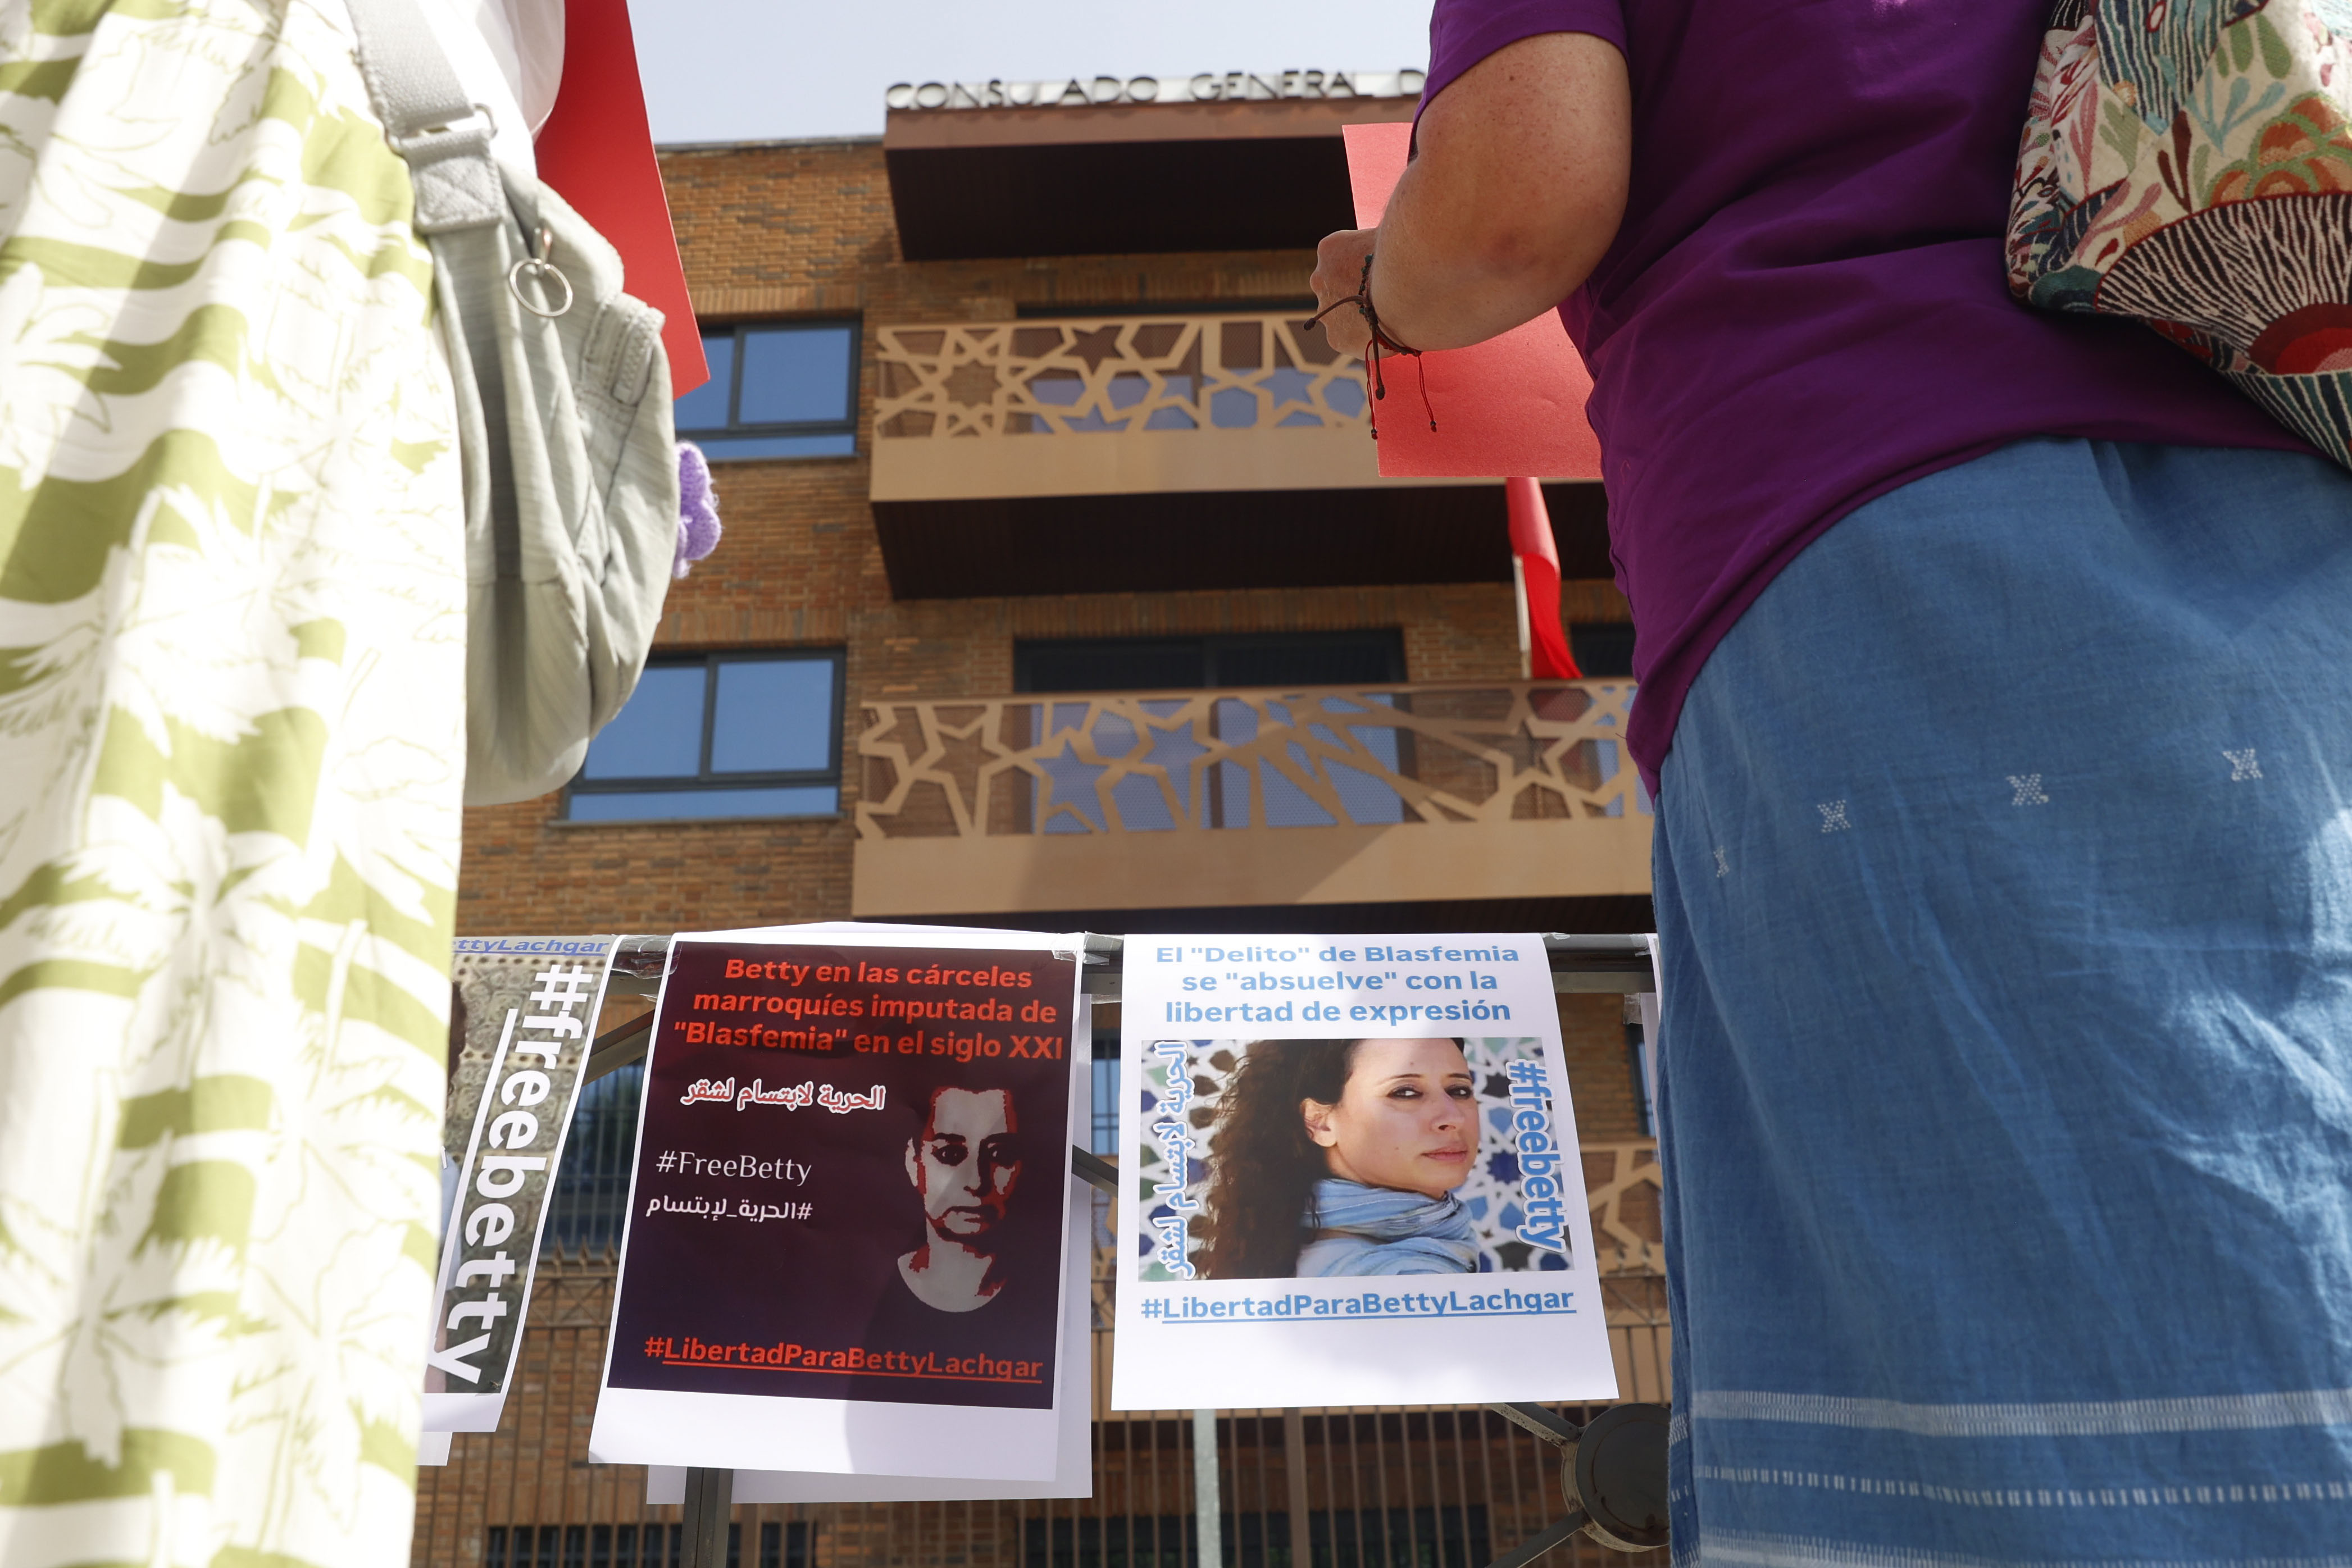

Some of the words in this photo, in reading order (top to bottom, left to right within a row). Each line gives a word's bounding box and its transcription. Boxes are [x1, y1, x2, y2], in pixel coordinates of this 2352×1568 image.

[886, 75, 1156, 110] CONSULADO
[1190, 70, 1374, 102] GENERAL
[1399, 69, 1428, 96] D
[452, 938, 609, 955] ttyLachgar
[1158, 949, 1181, 962] El
[1190, 947, 1311, 963] "Delito"
[1320, 946, 1355, 961] de
[1366, 946, 1518, 961] Blasfemia
[725, 959, 809, 987] Betty
[816, 965, 851, 982] en
[857, 961, 899, 983] las
[906, 963, 1032, 988] cárceles
[1184, 977, 1216, 990] se
[1227, 972, 1398, 991] "absuelve"
[1406, 976, 1462, 990] con
[1471, 971, 1497, 990] la
[693, 993, 863, 1019] marroquíes
[871, 993, 1013, 1024] imputada
[1021, 999, 1057, 1023] de
[1167, 1001, 1292, 1022] libertad
[1303, 1001, 1340, 1020] de
[1350, 1000, 1511, 1026] expresión
[674, 1021, 848, 1050] "Blasfemia"
[854, 1034, 889, 1053] en
[898, 1031, 923, 1054] el
[931, 1031, 1001, 1063] siglo
[1008, 1035, 1062, 1059] XXI
[680, 1077, 735, 1105] لشقر
[1155, 1041, 1194, 1115] الحرية
[817, 1084, 886, 1114] الحرية
[656, 1150, 812, 1186] #FreeBetty
[1506, 1059, 1566, 1253] #freebetty
[429, 964, 593, 1384] #freebetty
[1153, 1216, 1196, 1280] لشقر
[1143, 1289, 1577, 1324] #LibertadParaBettyLachgar
[645, 1337, 1041, 1383] #LibertadParaBettyLachgar
